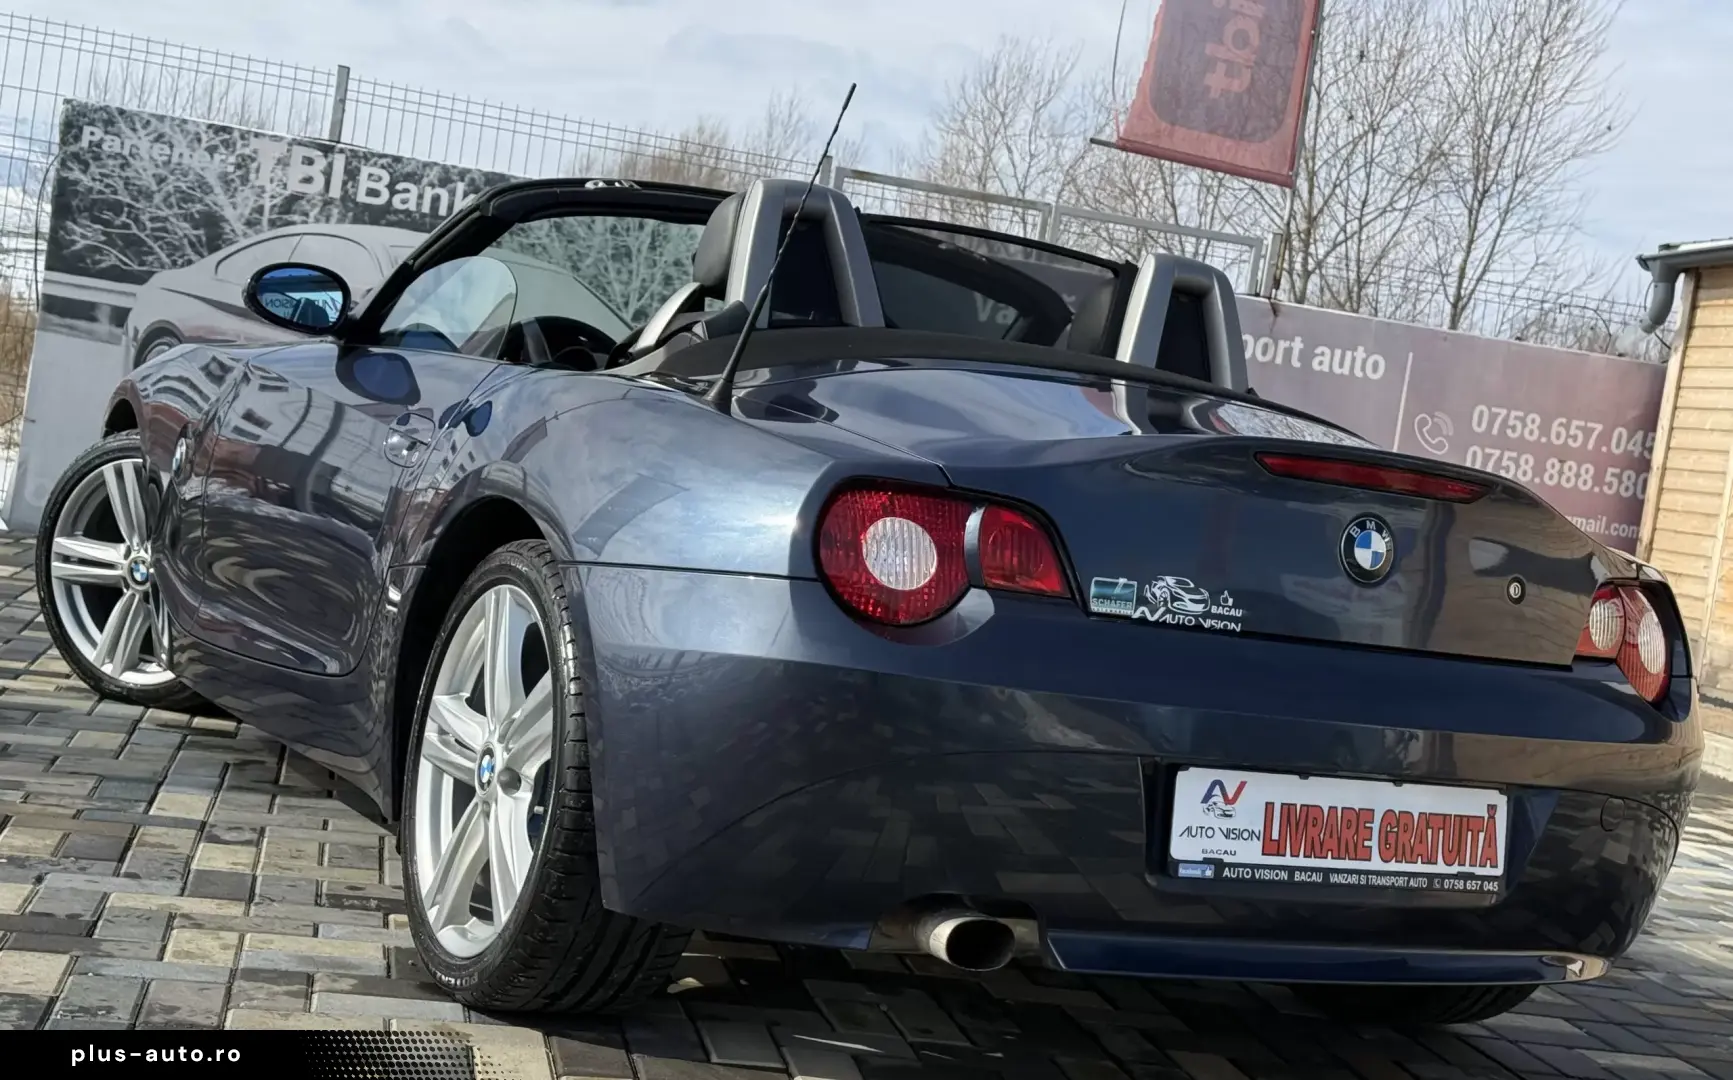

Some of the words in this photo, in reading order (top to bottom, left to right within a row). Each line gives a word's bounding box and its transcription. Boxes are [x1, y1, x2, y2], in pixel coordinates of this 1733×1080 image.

[251, 135, 346, 200] TBI
[356, 166, 478, 217] Bank
[1311, 345, 1385, 380] auto
[1349, 519, 1391, 543] BMW
[1211, 605, 1243, 617] BACAU
[1159, 614, 1196, 626] AUTO
[1199, 617, 1242, 633] VISION
[1179, 825, 1216, 839] AUTO
[1219, 827, 1261, 842] VISION
[1261, 801, 1375, 862] LIVRARE
[1378, 804, 1499, 869] GRATUITĂ
[1201, 848, 1237, 857] BACAU
[1222, 867, 1252, 879] AUTO
[1254, 869, 1289, 881] VISION
[1294, 871, 1323, 883] BACAU
[1329, 872, 1359, 885] VANZARI
[1360, 875, 1367, 884] SI
[1368, 876, 1408, 888] TRANSPORT
[1409, 877, 1428, 889] AUTO
[1443, 878, 1464, 890] 0758
[1466, 880, 1481, 891] 657
[1483, 880, 1499, 892] 045
